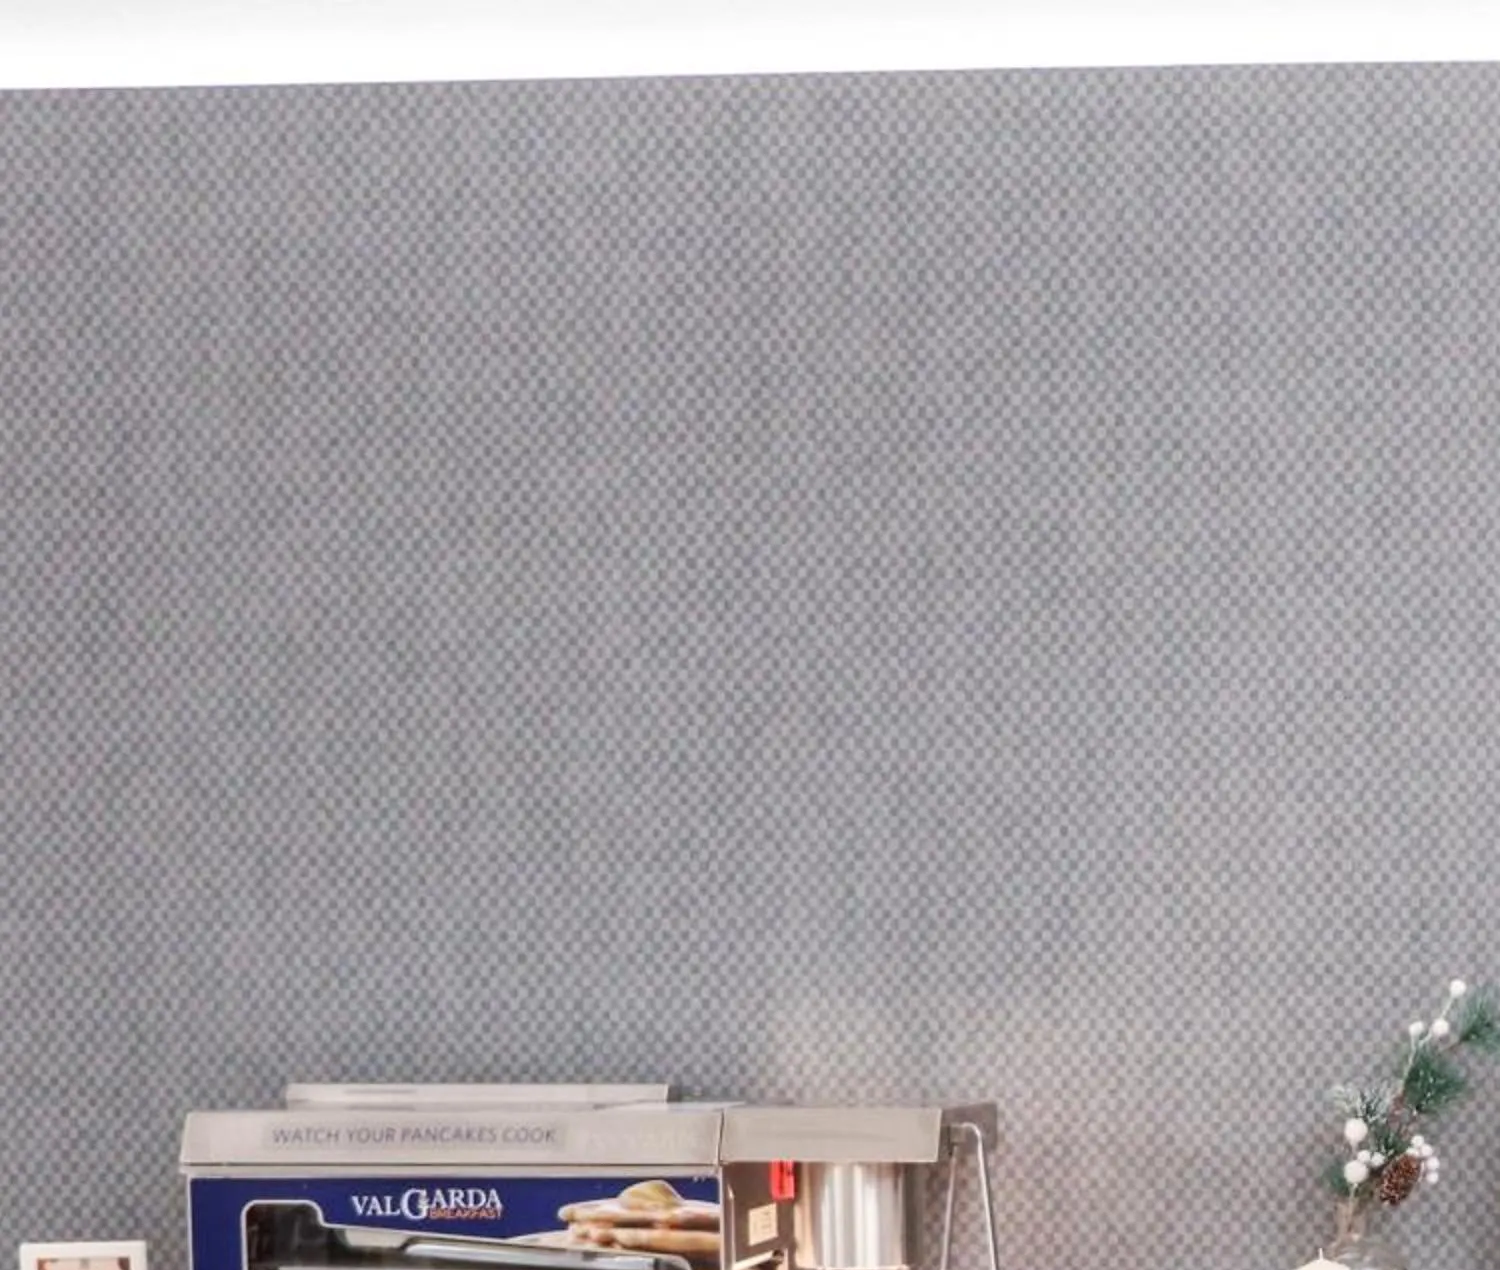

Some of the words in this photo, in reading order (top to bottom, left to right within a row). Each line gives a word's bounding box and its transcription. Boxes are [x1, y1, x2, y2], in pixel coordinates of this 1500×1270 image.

[272, 1128, 340, 1144] WATCH
[347, 1127, 396, 1143] YOUR
[401, 1126, 498, 1143] PANCAKES
[502, 1126, 557, 1143] COOK
